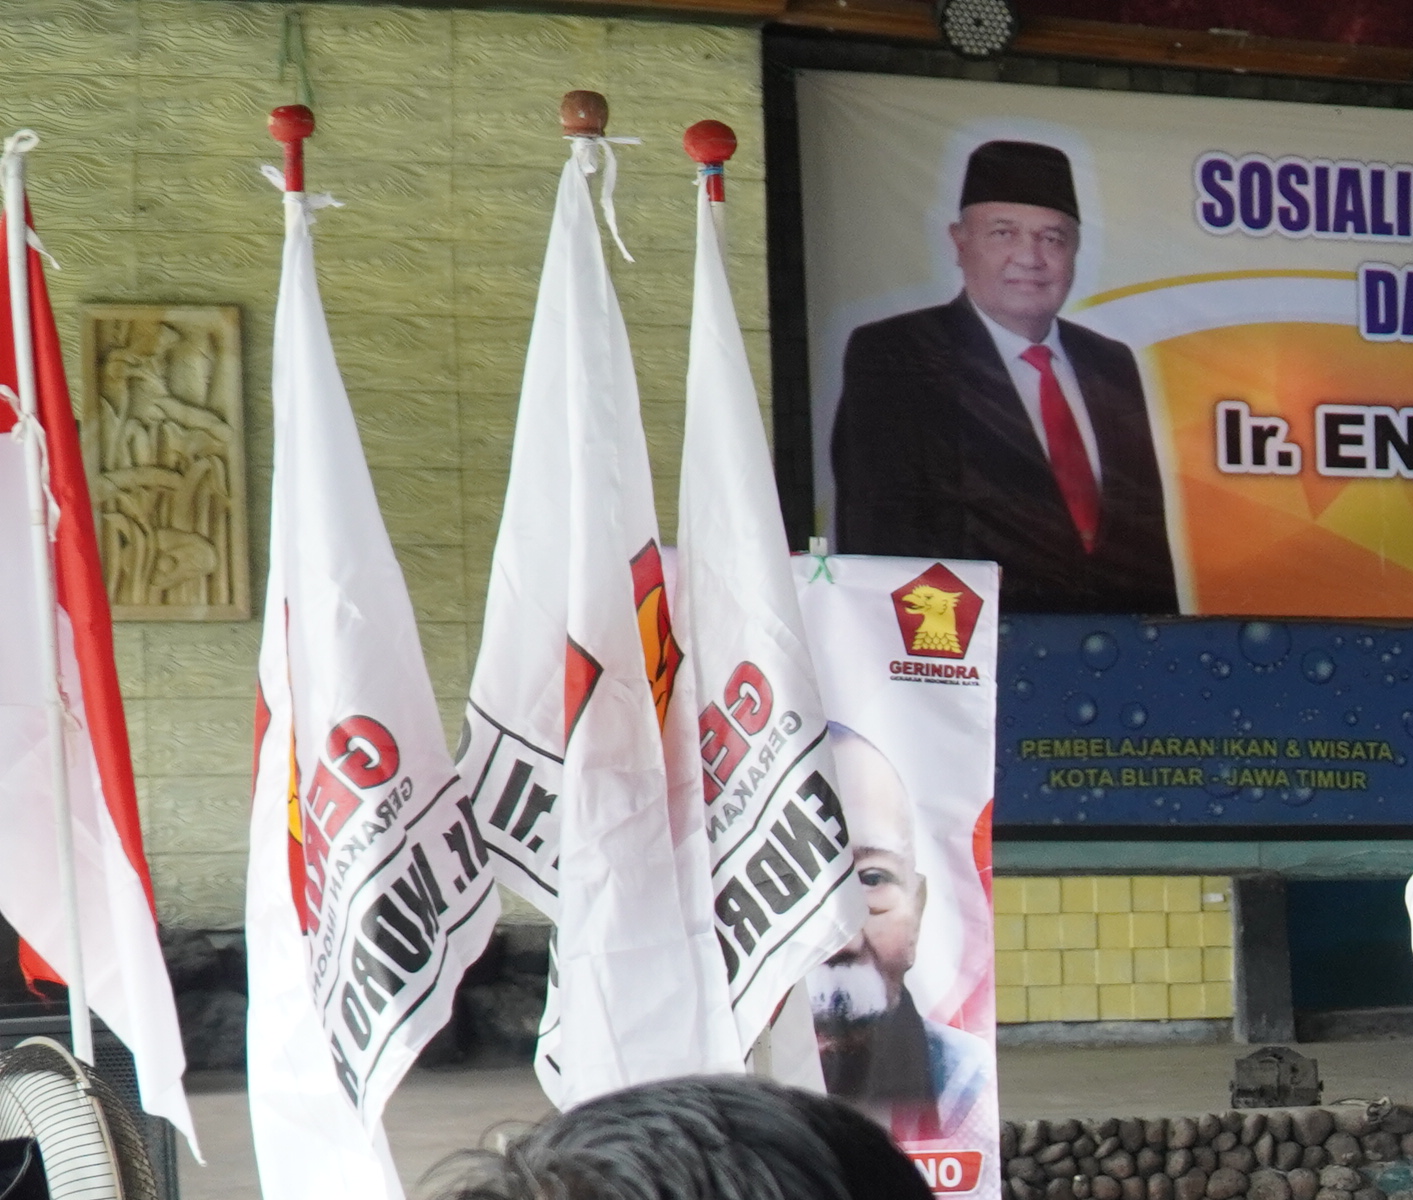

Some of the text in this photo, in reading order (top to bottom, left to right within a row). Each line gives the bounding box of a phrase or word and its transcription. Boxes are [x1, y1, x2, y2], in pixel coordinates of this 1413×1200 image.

[1222, 406, 1296, 469] Ir.
[889, 660, 980, 679] GERINDRA
[1020, 738, 1394, 762] PEMBELAJARAN IKAN & WISATA
[1049, 768, 1115, 787] KOTA
[1121, 768, 1204, 787] BLITAR
[1226, 768, 1290, 788] JAWA
[1296, 769, 1368, 789] TIMUR
[488, 759, 558, 853] Ir.
[914, 1157, 963, 1188] NO
